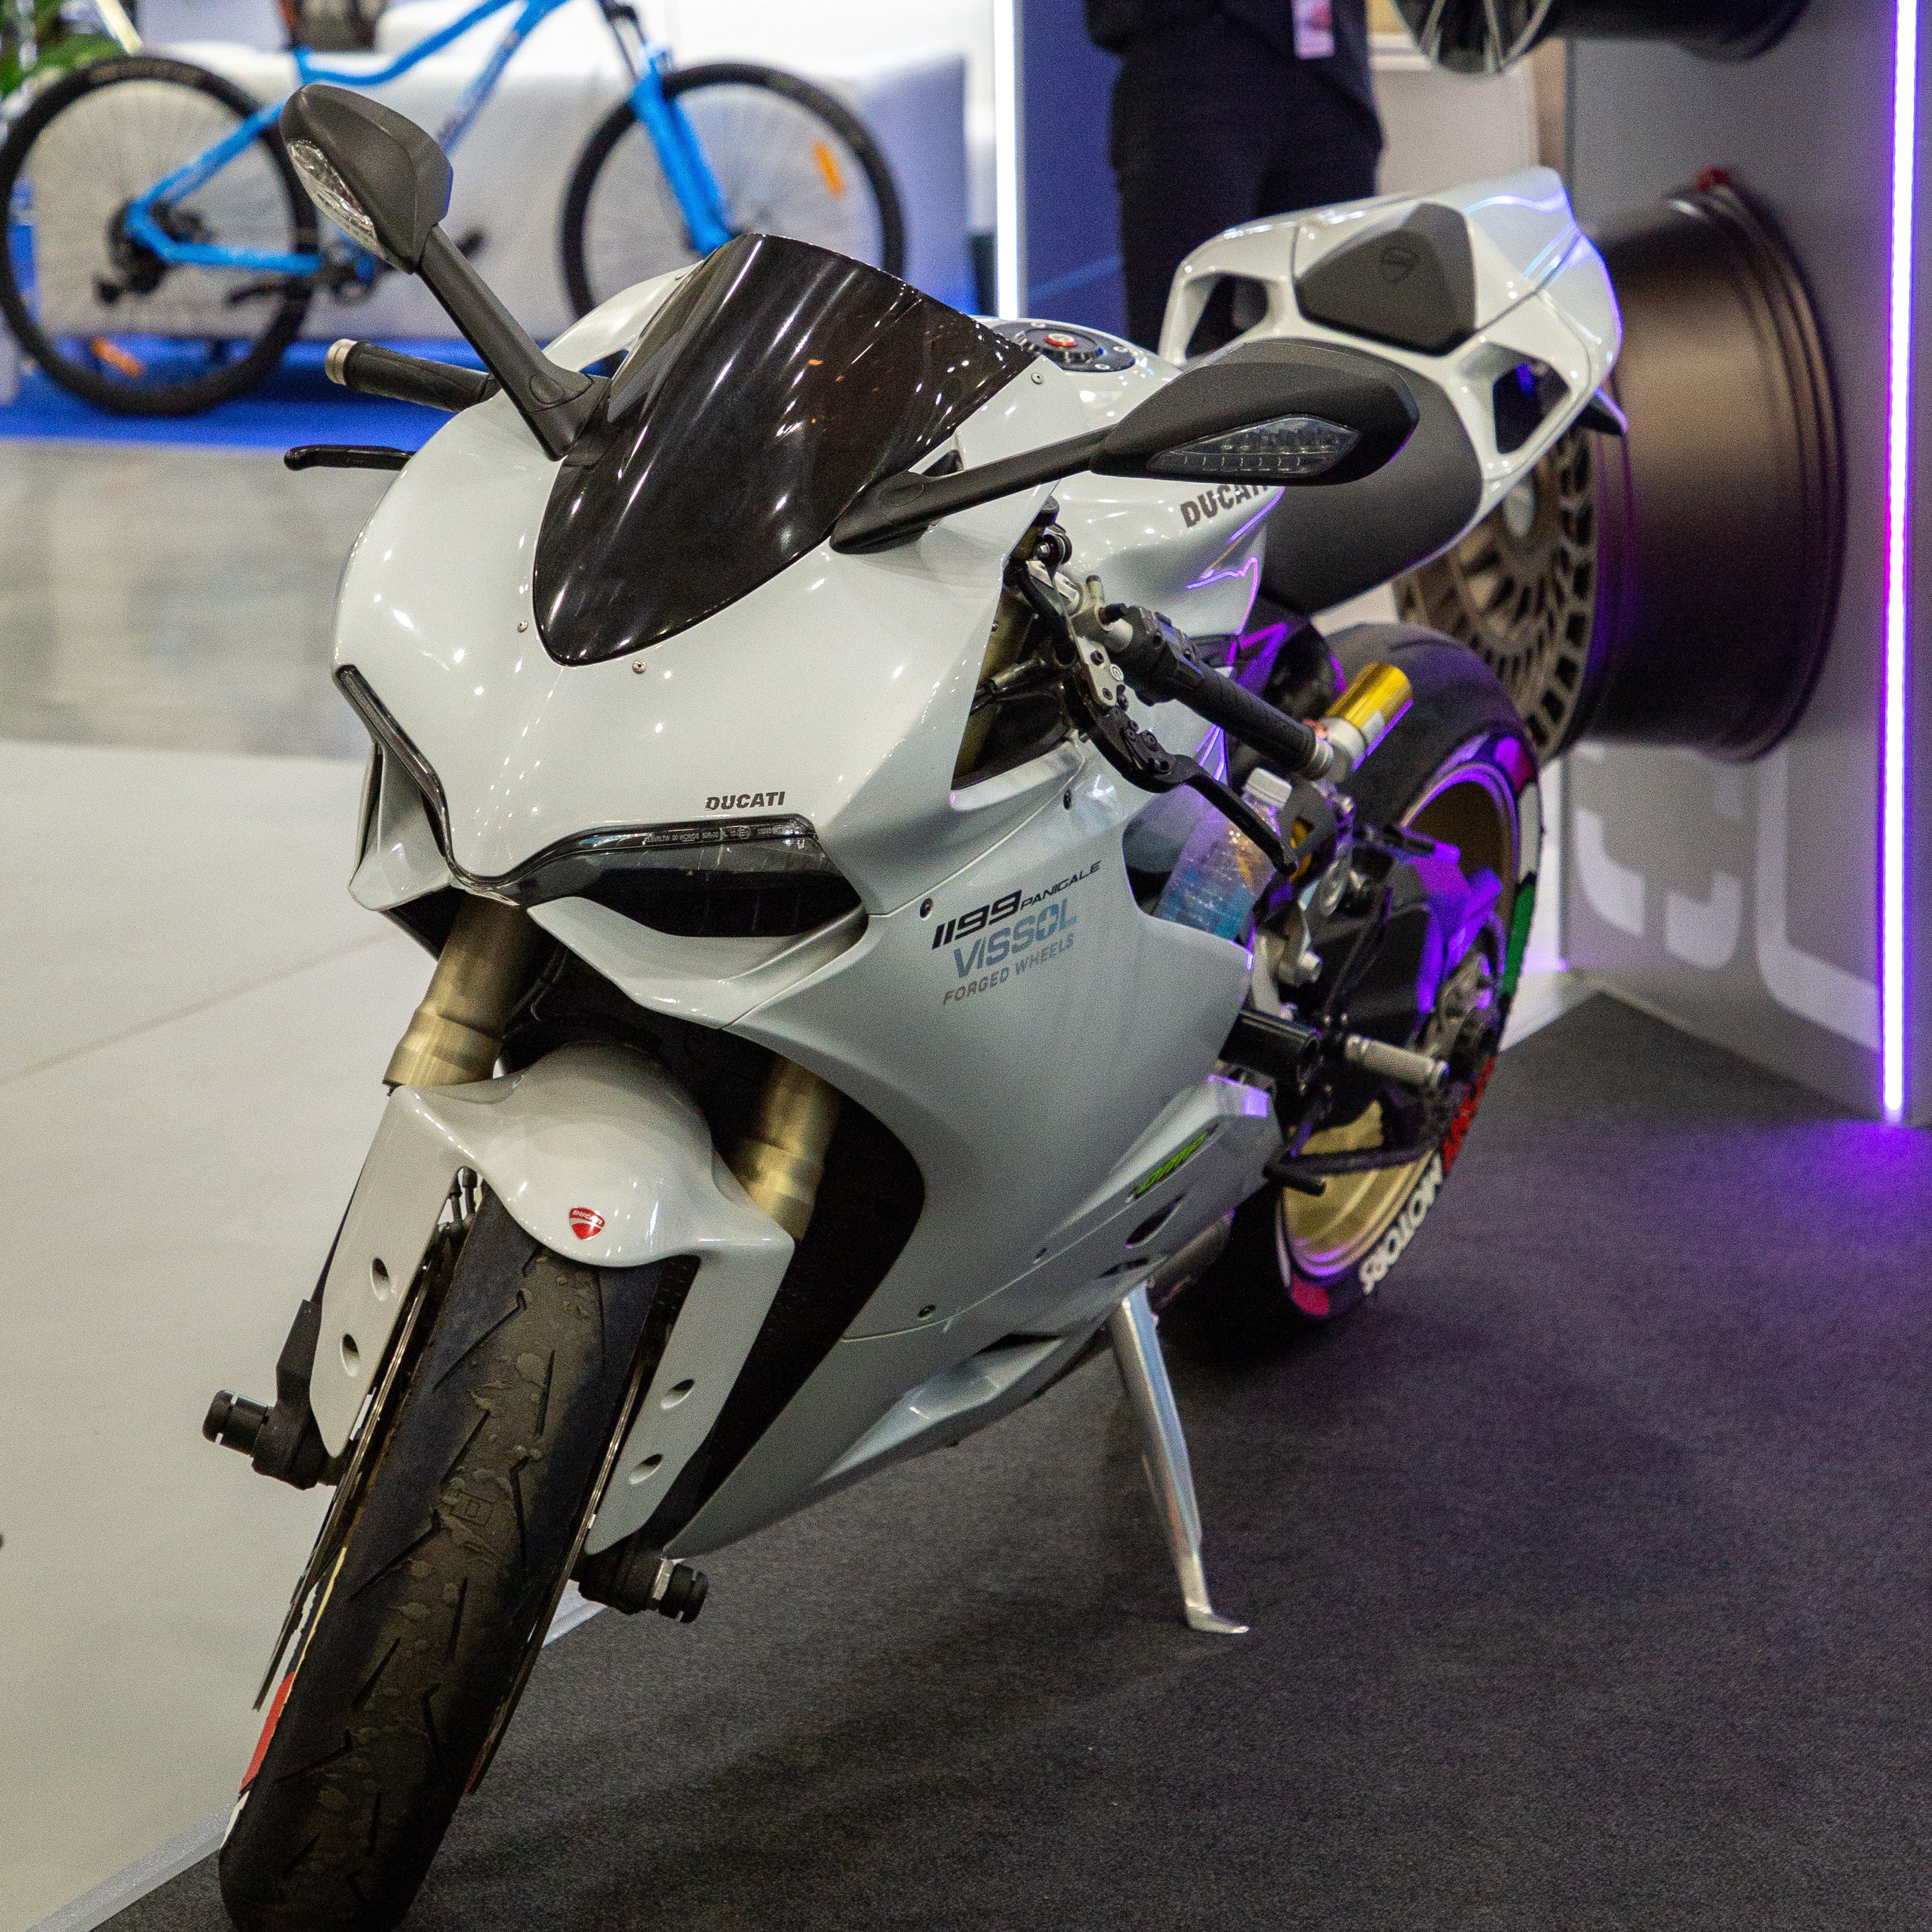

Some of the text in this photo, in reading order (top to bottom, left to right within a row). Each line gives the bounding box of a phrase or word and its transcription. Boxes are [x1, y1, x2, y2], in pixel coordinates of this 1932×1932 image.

[1180, 484, 1269, 528] DUCA
[705, 791, 786, 811] DUCATI
[931, 860, 1102, 950] 1199 PANIGALE
[953, 897, 1078, 979] VISSOL
[943, 932, 1075, 1005] FORGED WHEELS
[1359, 1153, 1444, 1295] MOTORS
